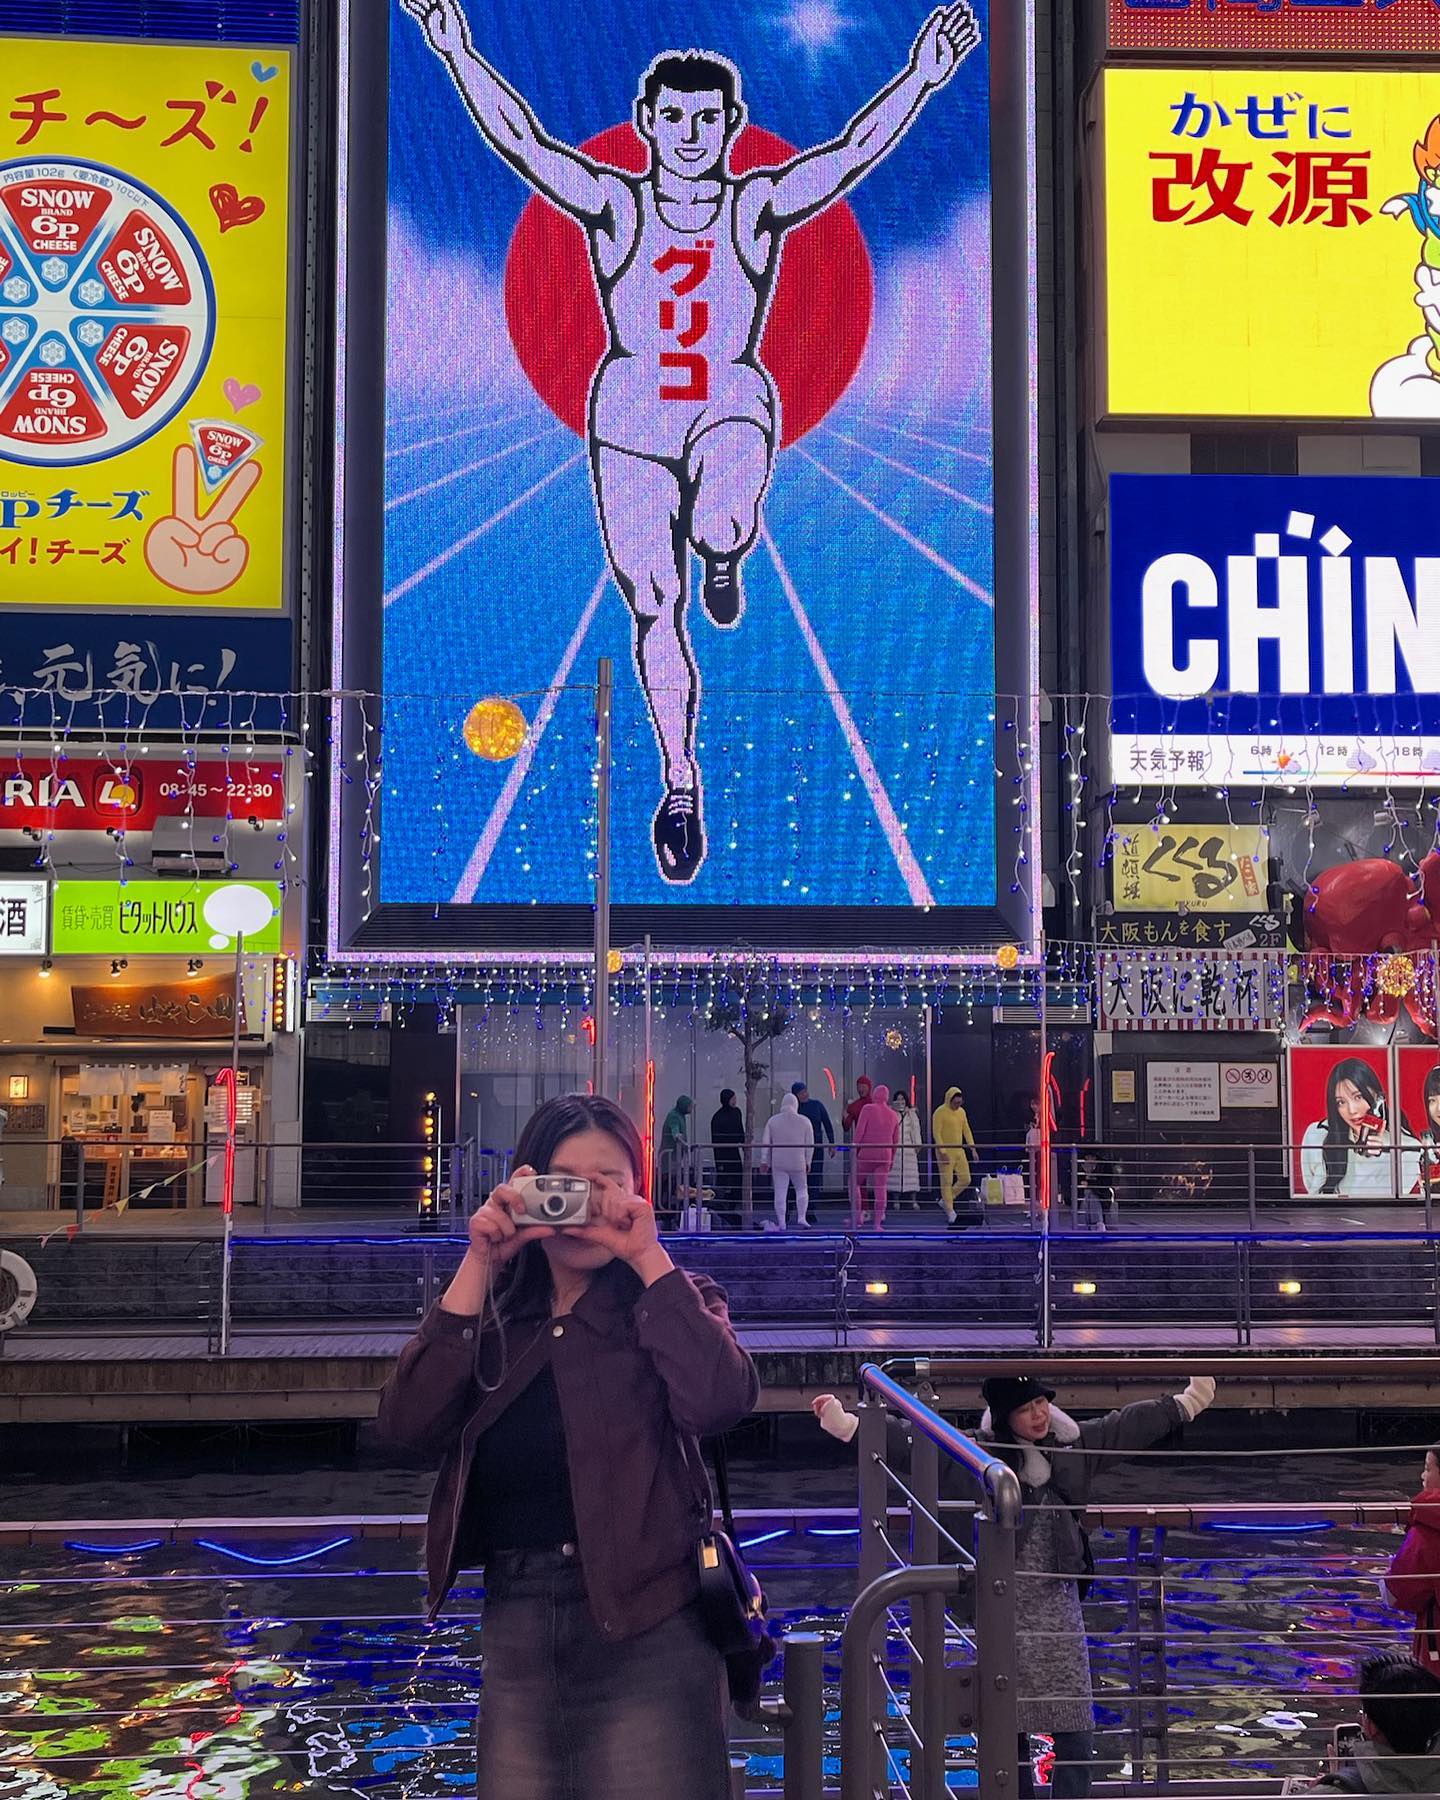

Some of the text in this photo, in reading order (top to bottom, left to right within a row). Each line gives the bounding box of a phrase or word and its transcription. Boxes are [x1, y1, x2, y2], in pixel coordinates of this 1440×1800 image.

[1169, 91, 1352, 139] かぜに
[21, 188, 95, 209] SNOW
[1148, 147, 1373, 228] 改源
[41, 208, 73, 216] BRAND
[31, 215, 80, 239] 6P
[33, 239, 78, 251] CHEESE
[134, 227, 184, 291] SNOW
[116, 249, 145, 293] 6P
[137, 252, 155, 280] BRAND
[101, 260, 129, 301] CHEESE
[652, 240, 714, 400] グリコ
[99, 328, 128, 367] CHEESE
[113, 335, 149, 377] 6P
[30, 372, 75, 383] CHEESE
[130, 339, 179, 407] SNOW
[133, 351, 153, 380] BRAND
[28, 384, 77, 408] 6P
[12, 414, 87, 435] SNOW
[206, 430, 243, 447] SNOW
[1130, 750, 1205, 772] 天気予報
[1319, 745, 1348, 757] 12時
[1394, 746, 1423, 757] 18時
[1142, 835, 1238, 899] くくる
[119, 900, 199, 935] ピタットハウス
[1101, 919, 1231, 944] 大阪もんを食す
[1259, 933, 1282, 947] 2F
[1109, 961, 1258, 1017] 大阪に乾杯
